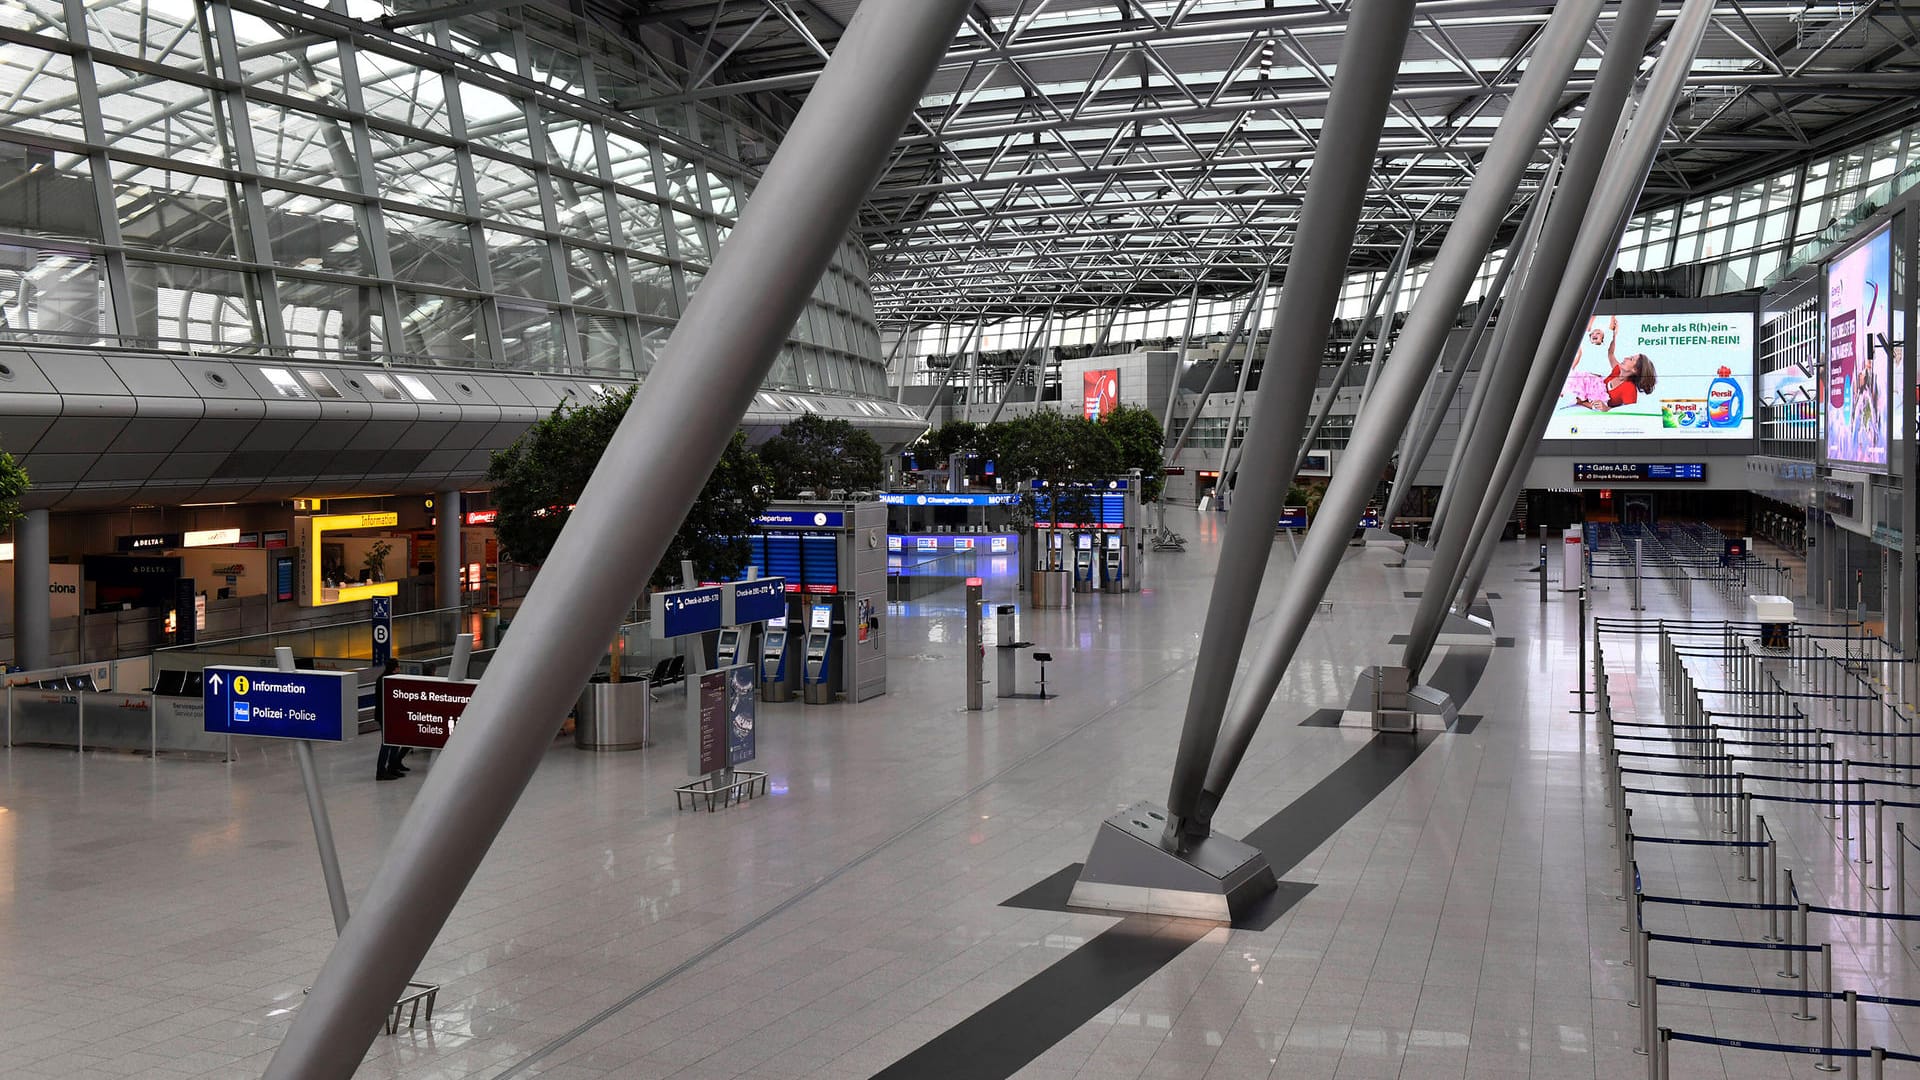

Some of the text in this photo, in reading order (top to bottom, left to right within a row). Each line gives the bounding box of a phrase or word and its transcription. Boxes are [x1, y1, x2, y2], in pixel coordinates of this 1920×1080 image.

[1641, 323, 1669, 333] Mehr
[1672, 323, 1687, 332] als
[1689, 322, 1728, 333] R(h)ein
[1638, 335, 1740, 346] Persil TIEFEN-REIN!
[1711, 389, 1732, 398] Persil
[1675, 403, 1697, 411] Persil
[927, 495, 974, 504] ChangeGroup
[758, 514, 793, 523] Departures
[49, 582, 76, 593] ciona
[684, 595, 702, 605] Check-in
[252, 680, 306, 694] Information
[392, 689, 472, 704] Shops & Restauran
[252, 706, 283, 719] Polizei
[289, 709, 316, 721] Police
[407, 711, 443, 723] Toiletten
[417, 723, 443, 735] Toilets
